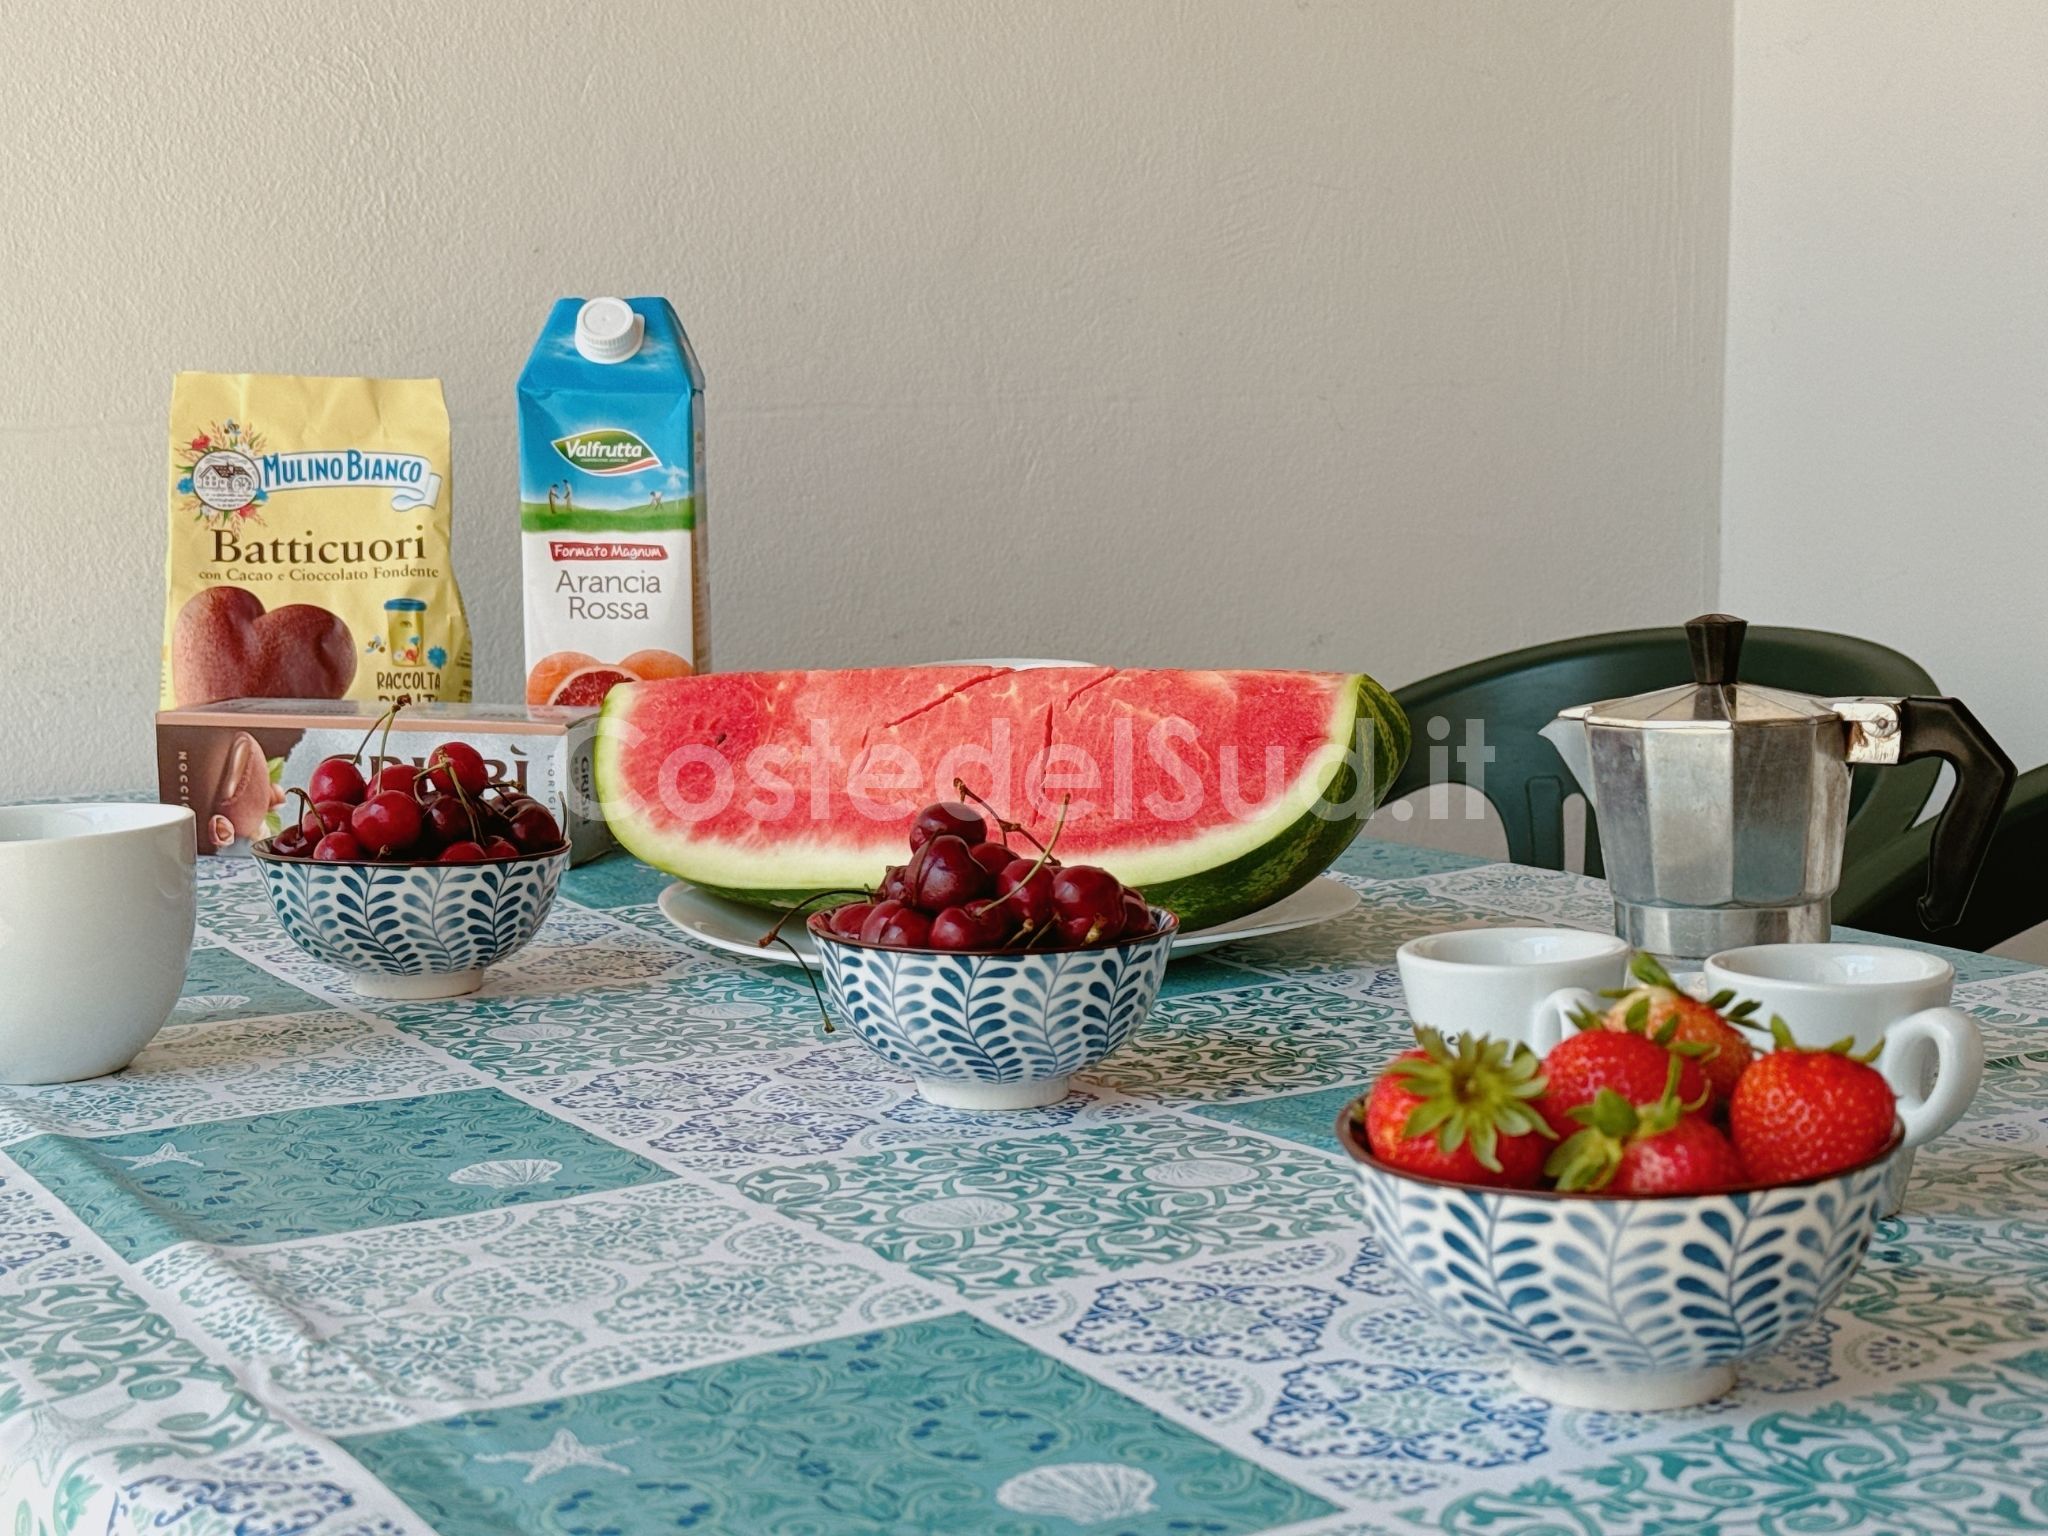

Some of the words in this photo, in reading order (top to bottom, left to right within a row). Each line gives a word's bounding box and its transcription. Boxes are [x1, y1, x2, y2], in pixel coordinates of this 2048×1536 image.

[565, 438, 643, 459] Valfrutta
[263, 452, 343, 487] MULINO
[347, 449, 423, 485] BIANCO
[211, 524, 427, 565] Batticuori
[553, 543, 608, 558] Formato
[611, 544, 662, 560] Magnum
[198, 570, 221, 581] con
[226, 567, 273, 582] Cacao
[278, 573, 285, 581] e
[289, 566, 369, 582] Cioccolato
[373, 565, 440, 580] Fondente
[555, 569, 662, 594] Arancia
[568, 596, 650, 620] Rossa
[376, 671, 441, 690] RACCOLTA
